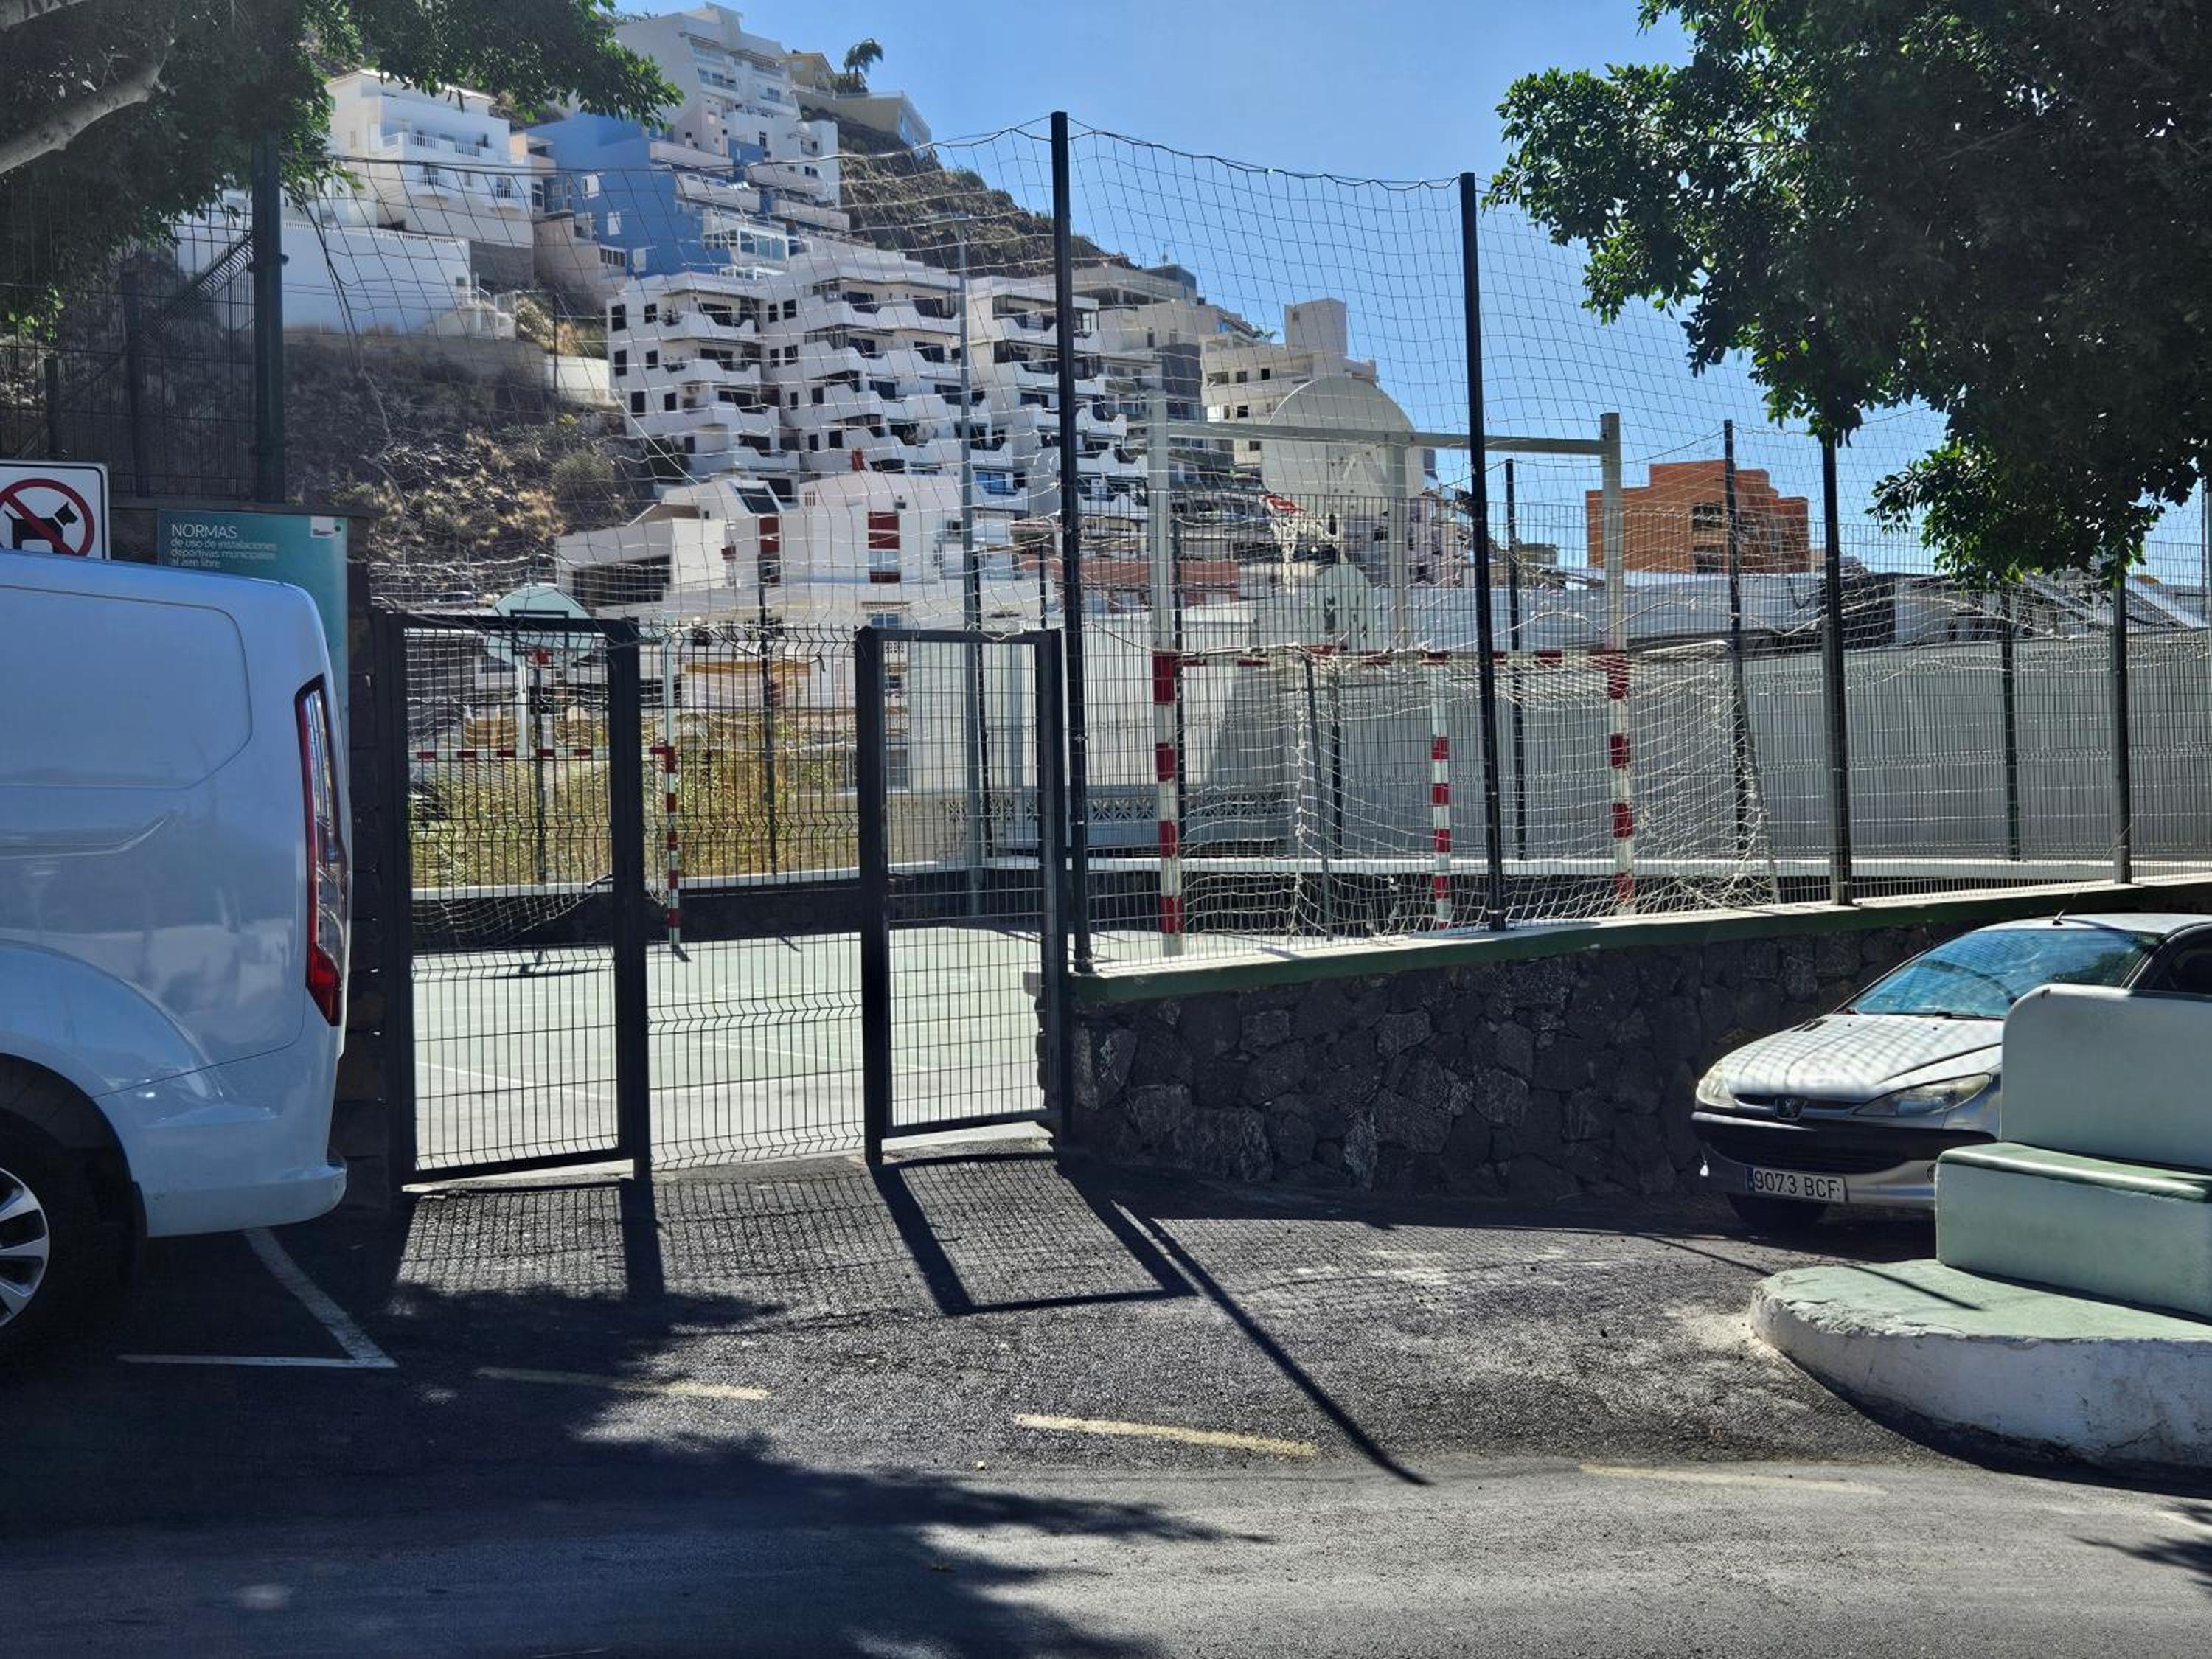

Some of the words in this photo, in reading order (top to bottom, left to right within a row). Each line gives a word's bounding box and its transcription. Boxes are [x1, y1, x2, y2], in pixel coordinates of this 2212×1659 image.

[171, 524, 237, 538] NORMAS
[171, 538, 184, 547] de
[185, 539, 203, 548] uso
[204, 539, 216, 549] de
[1754, 1170, 1797, 1194] 9073
[1804, 1177, 1837, 1199] BCF
